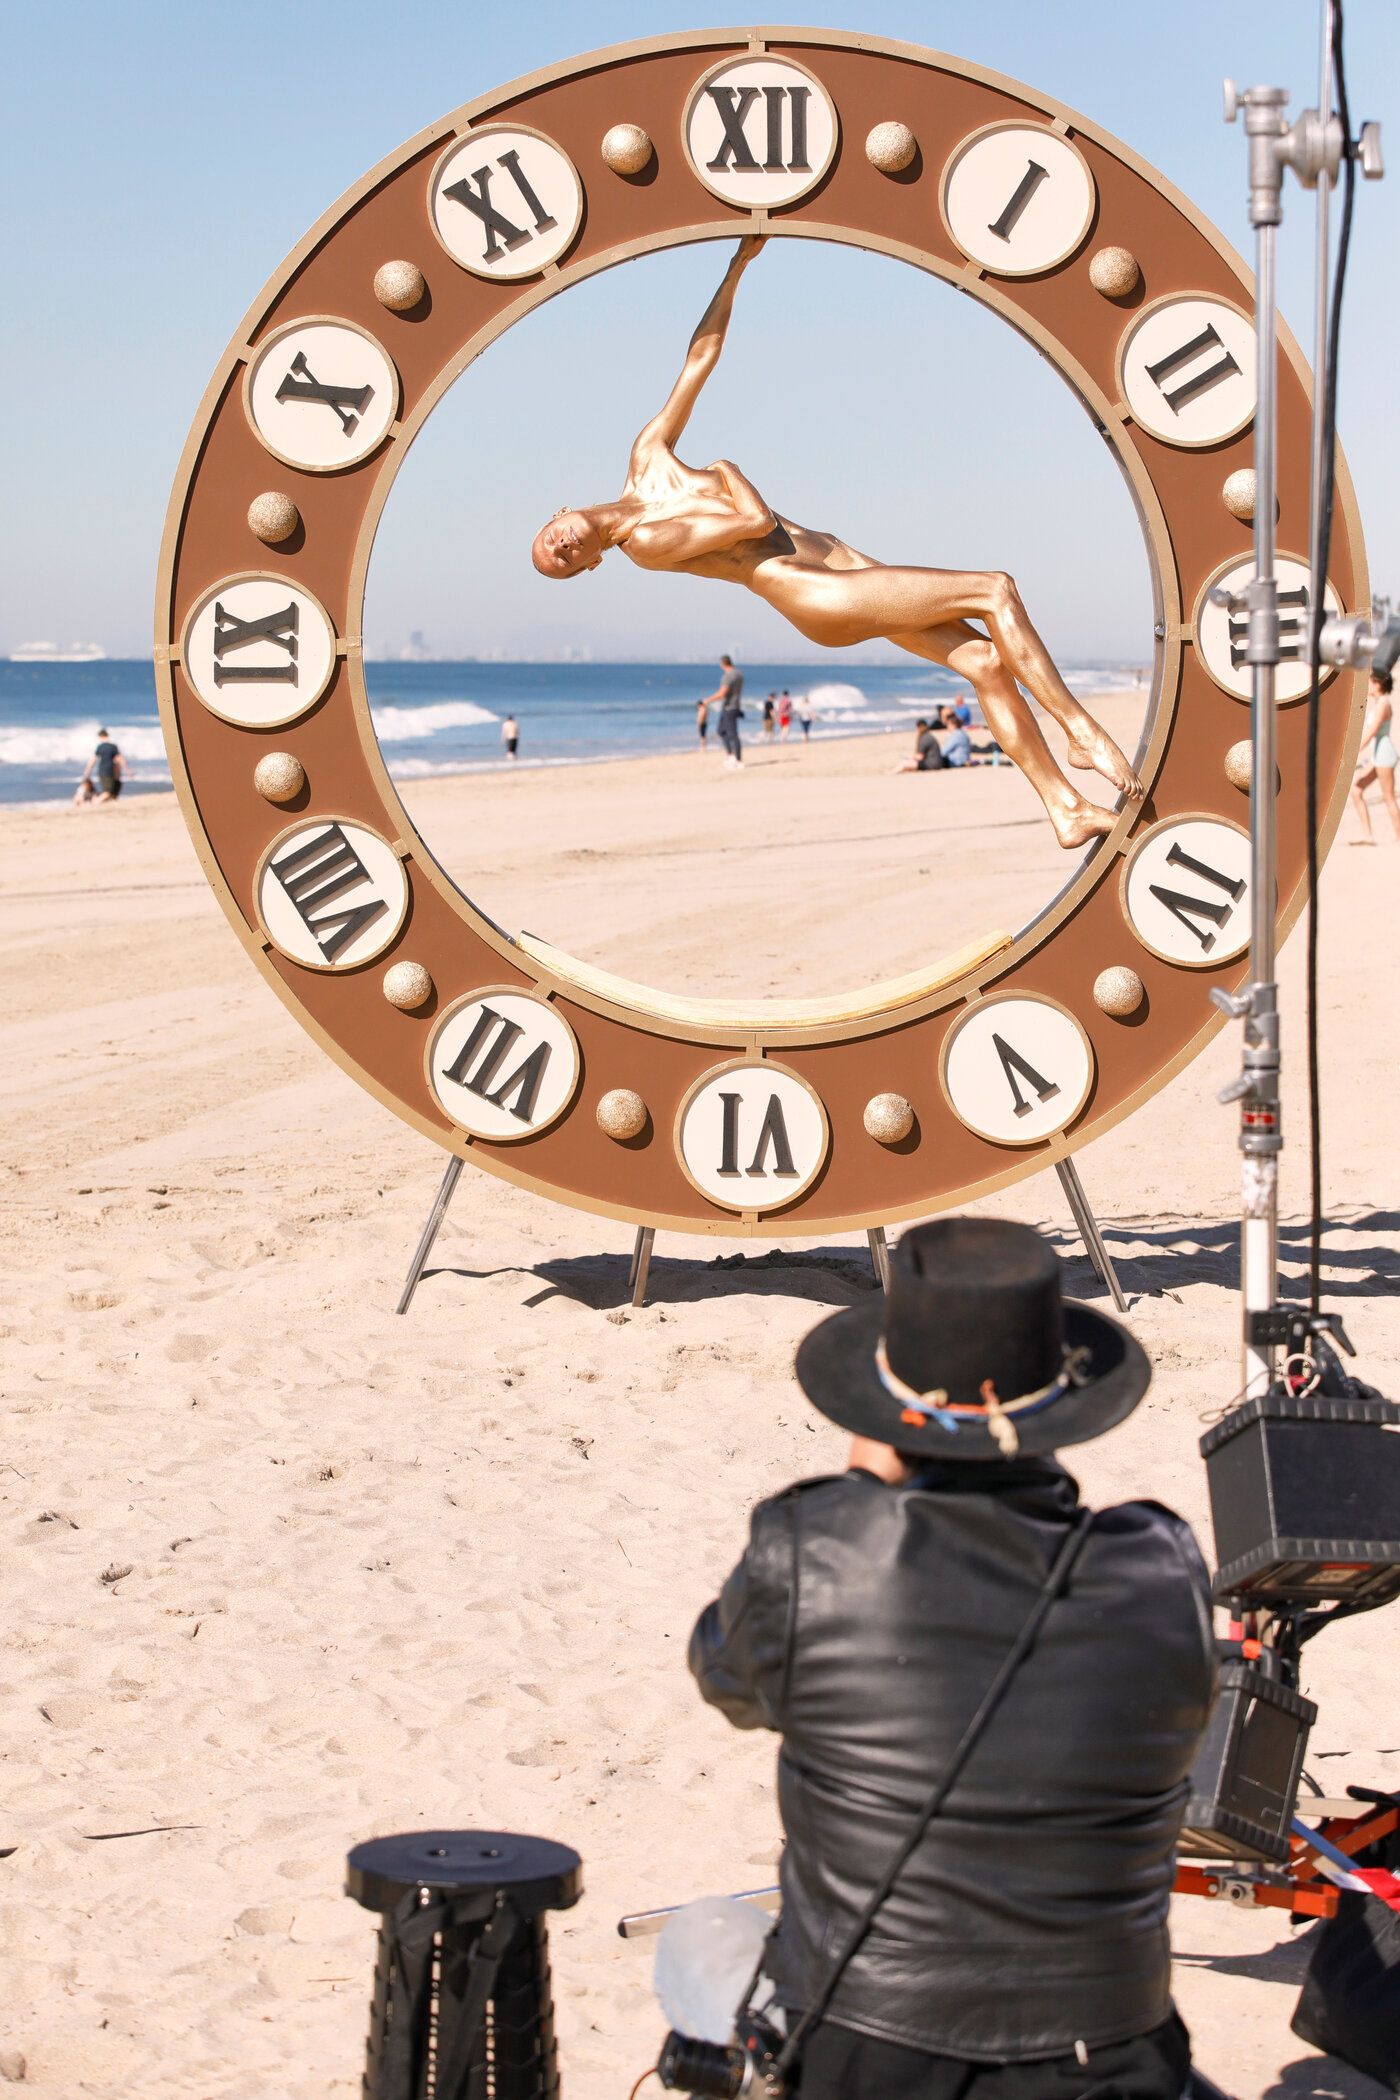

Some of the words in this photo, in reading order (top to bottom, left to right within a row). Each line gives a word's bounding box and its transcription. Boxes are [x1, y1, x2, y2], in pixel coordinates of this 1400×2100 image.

[704, 85, 808, 169] XII
[442, 149, 554, 259] XI
[987, 159, 1047, 240] I
[274, 351, 372, 433] X
[1144, 322, 1240, 412] II
[213, 601, 296, 683] IX
[269, 822, 386, 962] VIII
[1148, 842, 1245, 949] IV
[441, 1004, 549, 1122] VII
[992, 1033, 1057, 1114] V
[716, 1093, 797, 1174] VI
